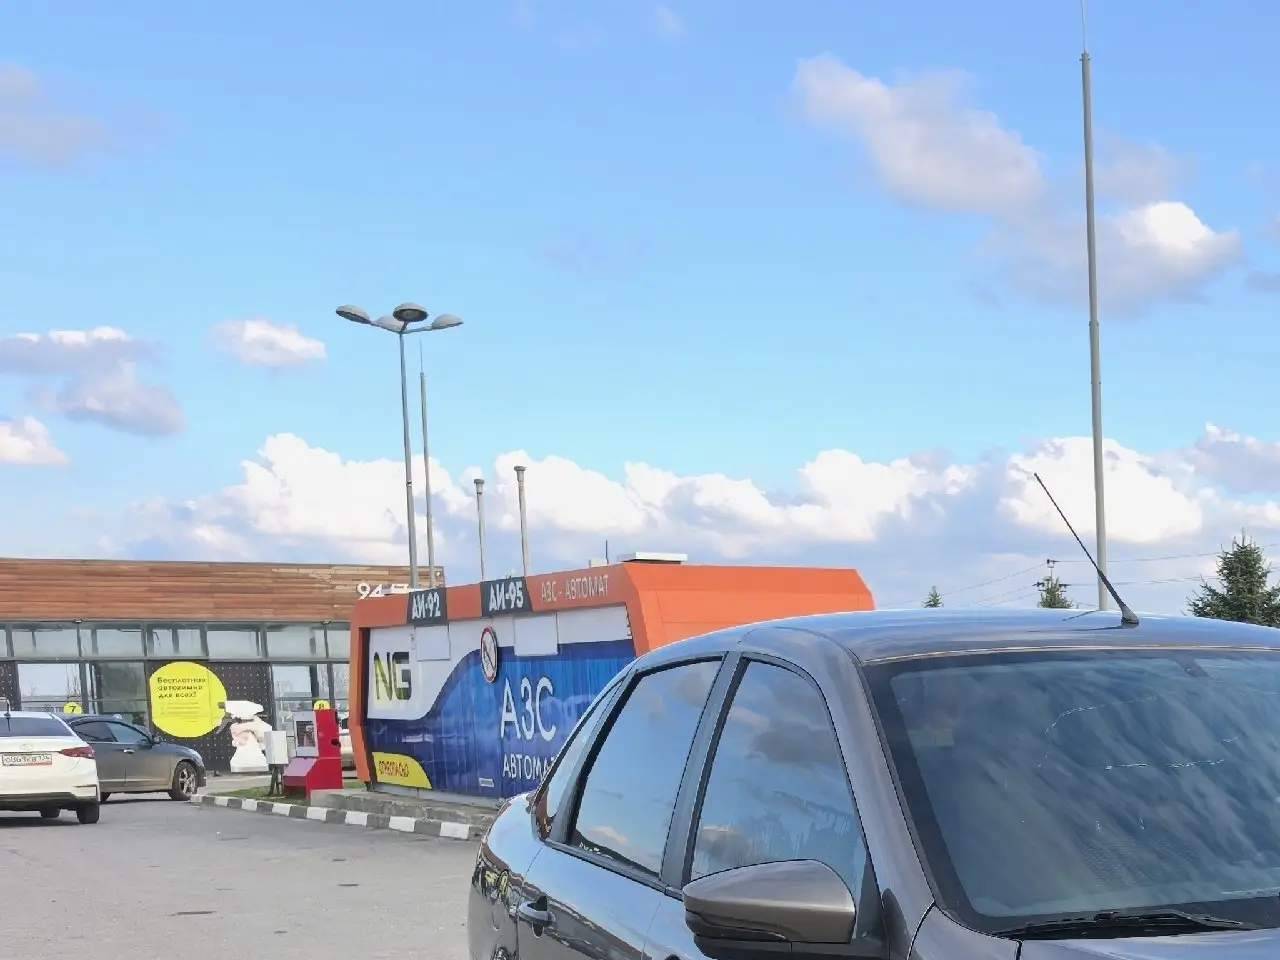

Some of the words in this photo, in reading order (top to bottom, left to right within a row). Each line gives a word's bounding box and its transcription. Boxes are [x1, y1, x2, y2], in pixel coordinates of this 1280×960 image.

[488, 581, 524, 612] АИ-95
[541, 580, 557, 602] АЗС
[565, 574, 609, 600] АВТОМАТ
[411, 591, 442, 620] АИ-92
[374, 651, 412, 701] NG
[69, 705, 77, 714] 7
[500, 676, 557, 742] АЗС
[502, 753, 557, 781] АВТОМА
